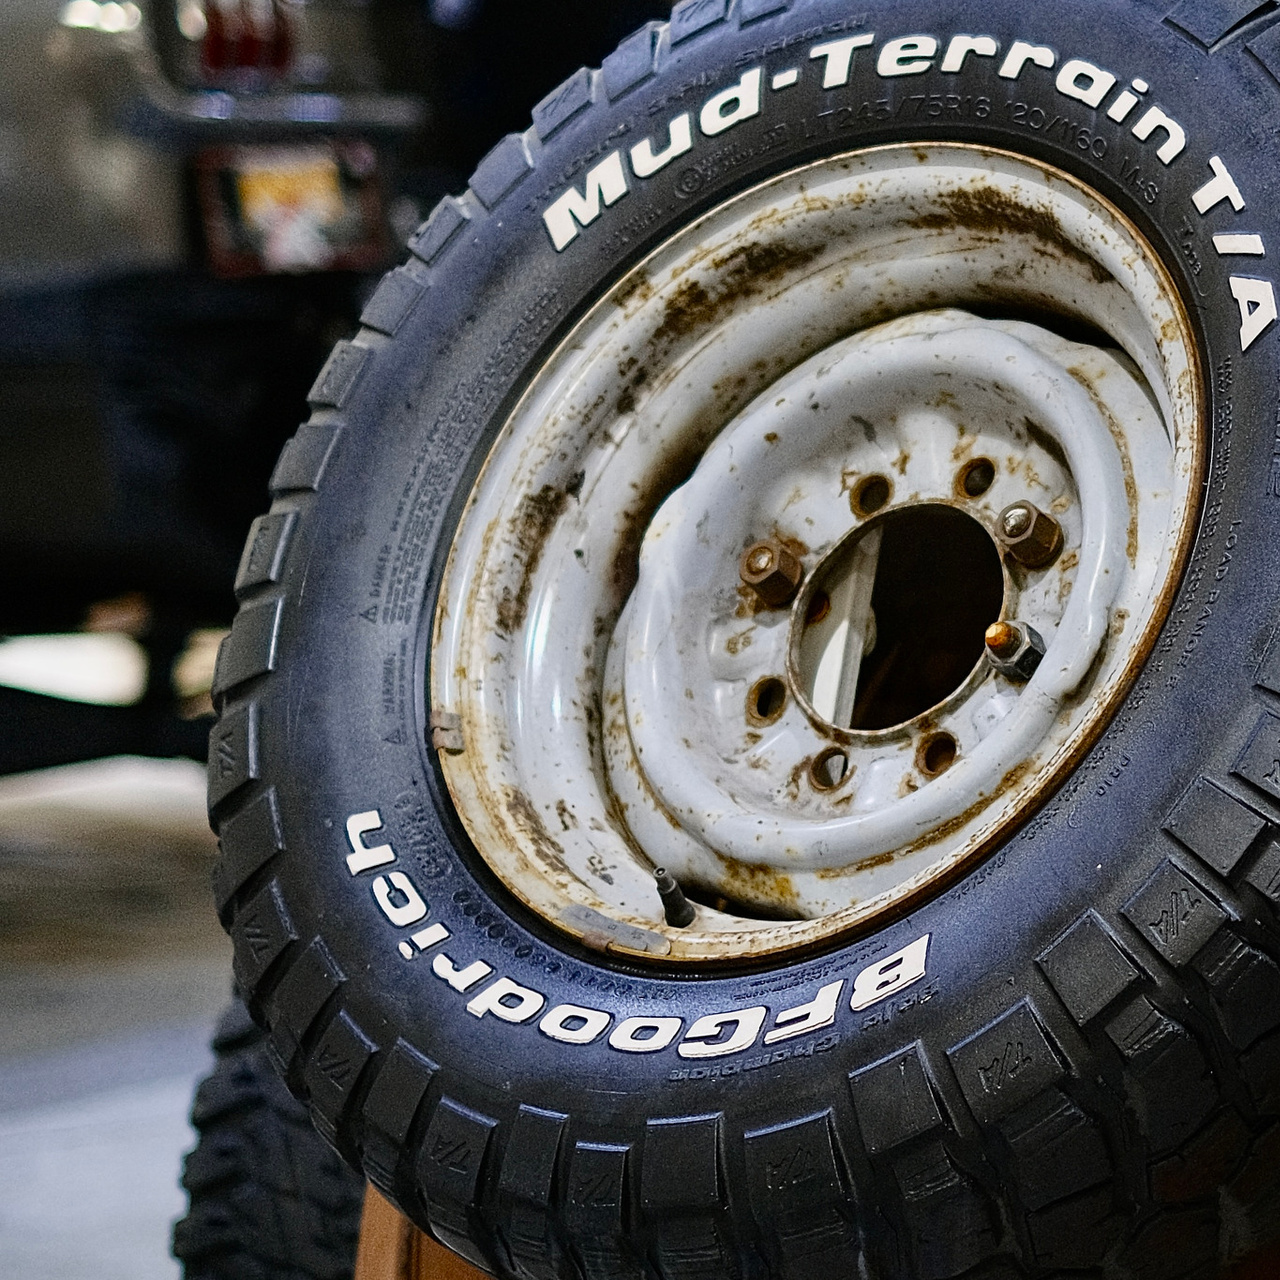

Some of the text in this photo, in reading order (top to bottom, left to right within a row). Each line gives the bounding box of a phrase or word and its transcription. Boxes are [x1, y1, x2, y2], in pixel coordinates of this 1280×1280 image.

[543, 33, 1186, 252] Mud-Terrain
[1191, 155, 1278, 352] T/A
[1214, 519, 1242, 582] LOAD
[346, 809, 931, 1058] BFGoodrich
